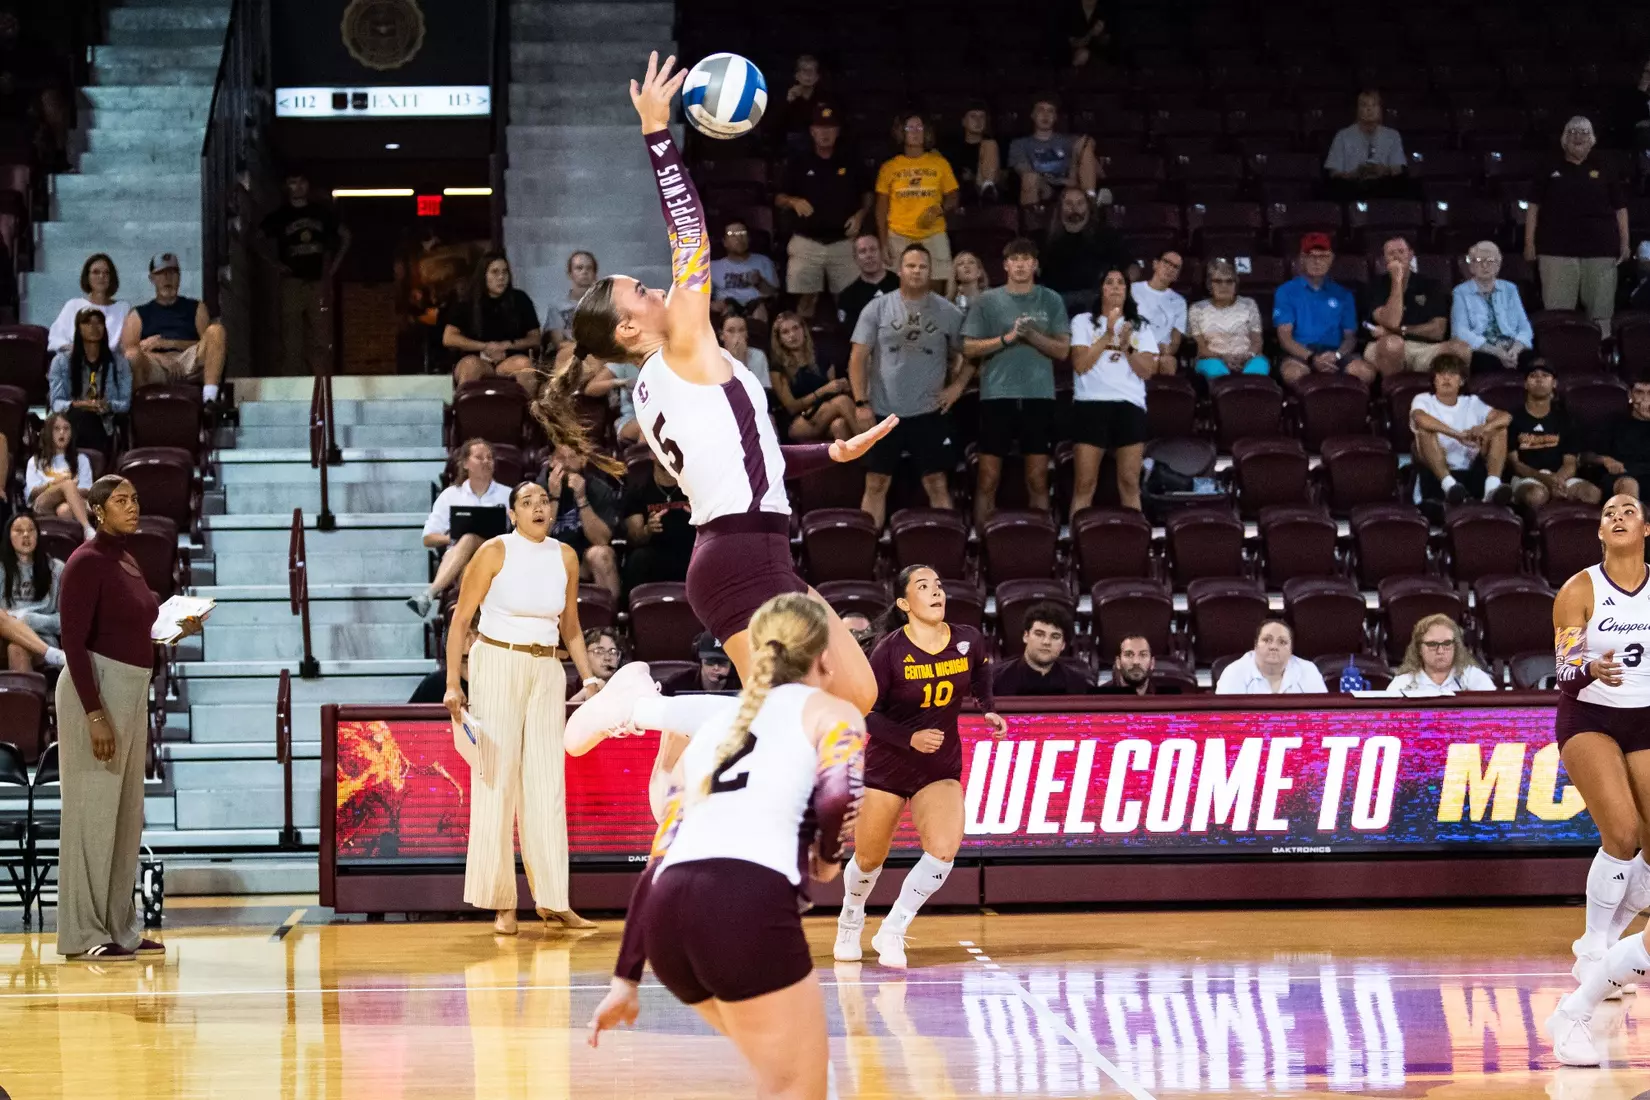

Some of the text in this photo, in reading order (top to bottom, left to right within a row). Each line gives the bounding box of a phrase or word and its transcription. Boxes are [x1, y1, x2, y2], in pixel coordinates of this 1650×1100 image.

[294, 93, 471, 108] 112 EXIT 113
[656, 163, 701, 249] CHIPPEWAS
[652, 411, 684, 475] 5
[904, 657, 970, 680] CENTRAL MICHIGAN
[1623, 643, 1645, 668] 3
[920, 680, 954, 708] 10
[711, 731, 758, 794] 2
[963, 737, 1302, 835] WELCOME
[1317, 735, 1402, 830] TO
[1271, 846, 1332, 854] DAKTRONICS
